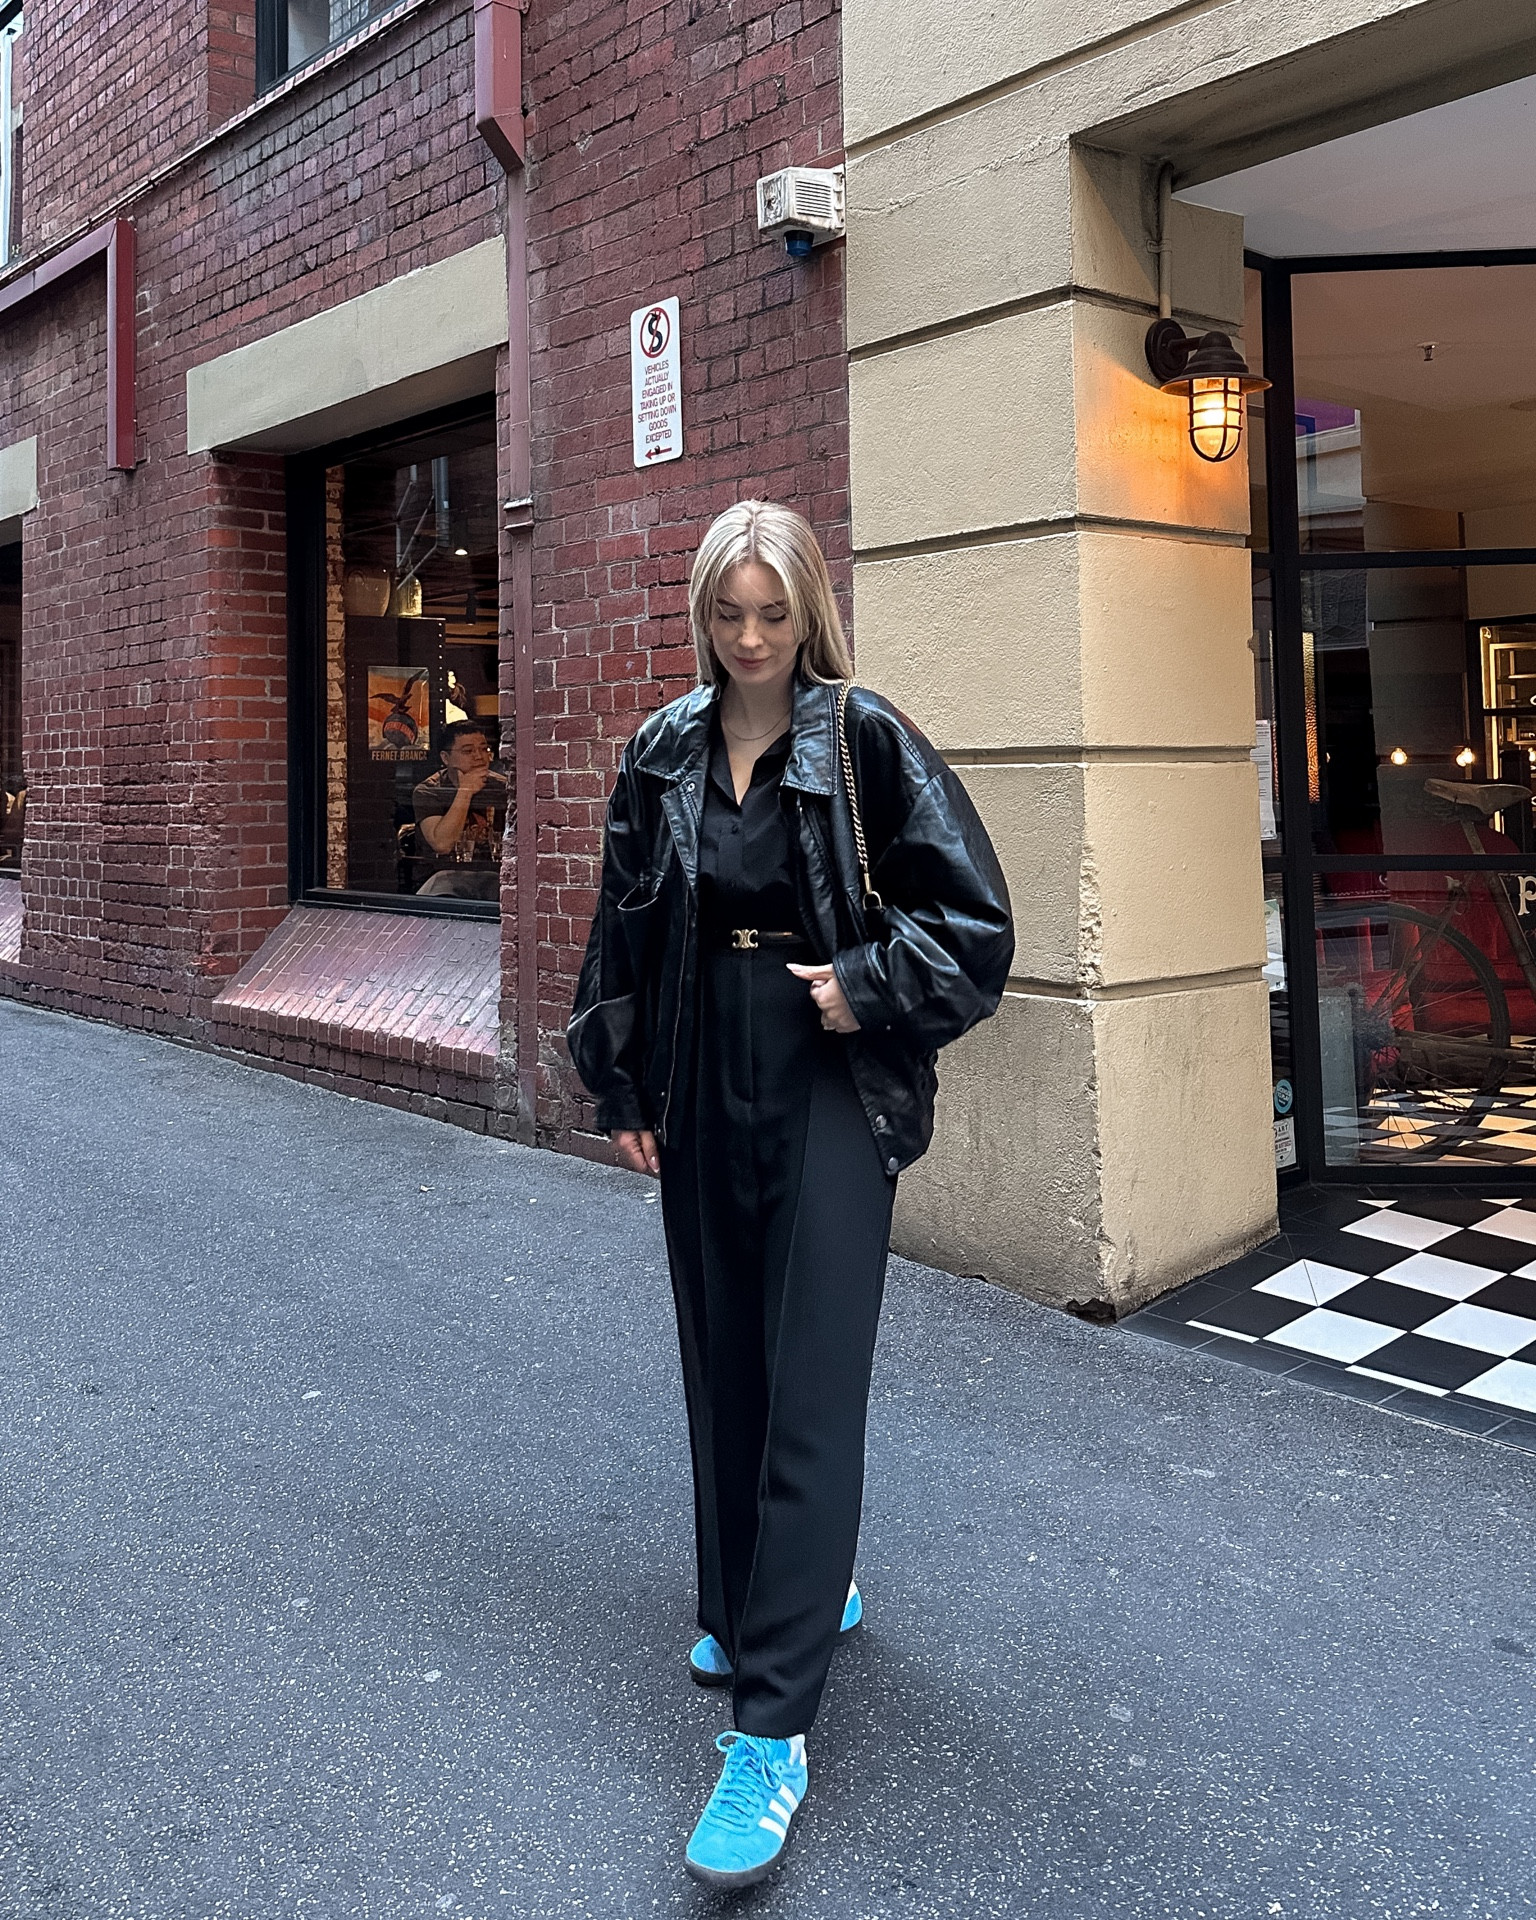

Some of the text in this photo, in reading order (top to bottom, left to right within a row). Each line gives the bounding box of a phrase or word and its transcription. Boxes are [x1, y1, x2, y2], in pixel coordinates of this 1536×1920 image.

[644, 360, 669, 375] VEHICLES
[644, 371, 669, 386] ACTUALLY
[642, 381, 673, 399] ENGAGED IN
[640, 393, 675, 411] TAKING UP OR
[638, 404, 676, 423] SETTING DOWN
[649, 418, 668, 431] GOODS
[645, 429, 672, 444] EXCEPTED
